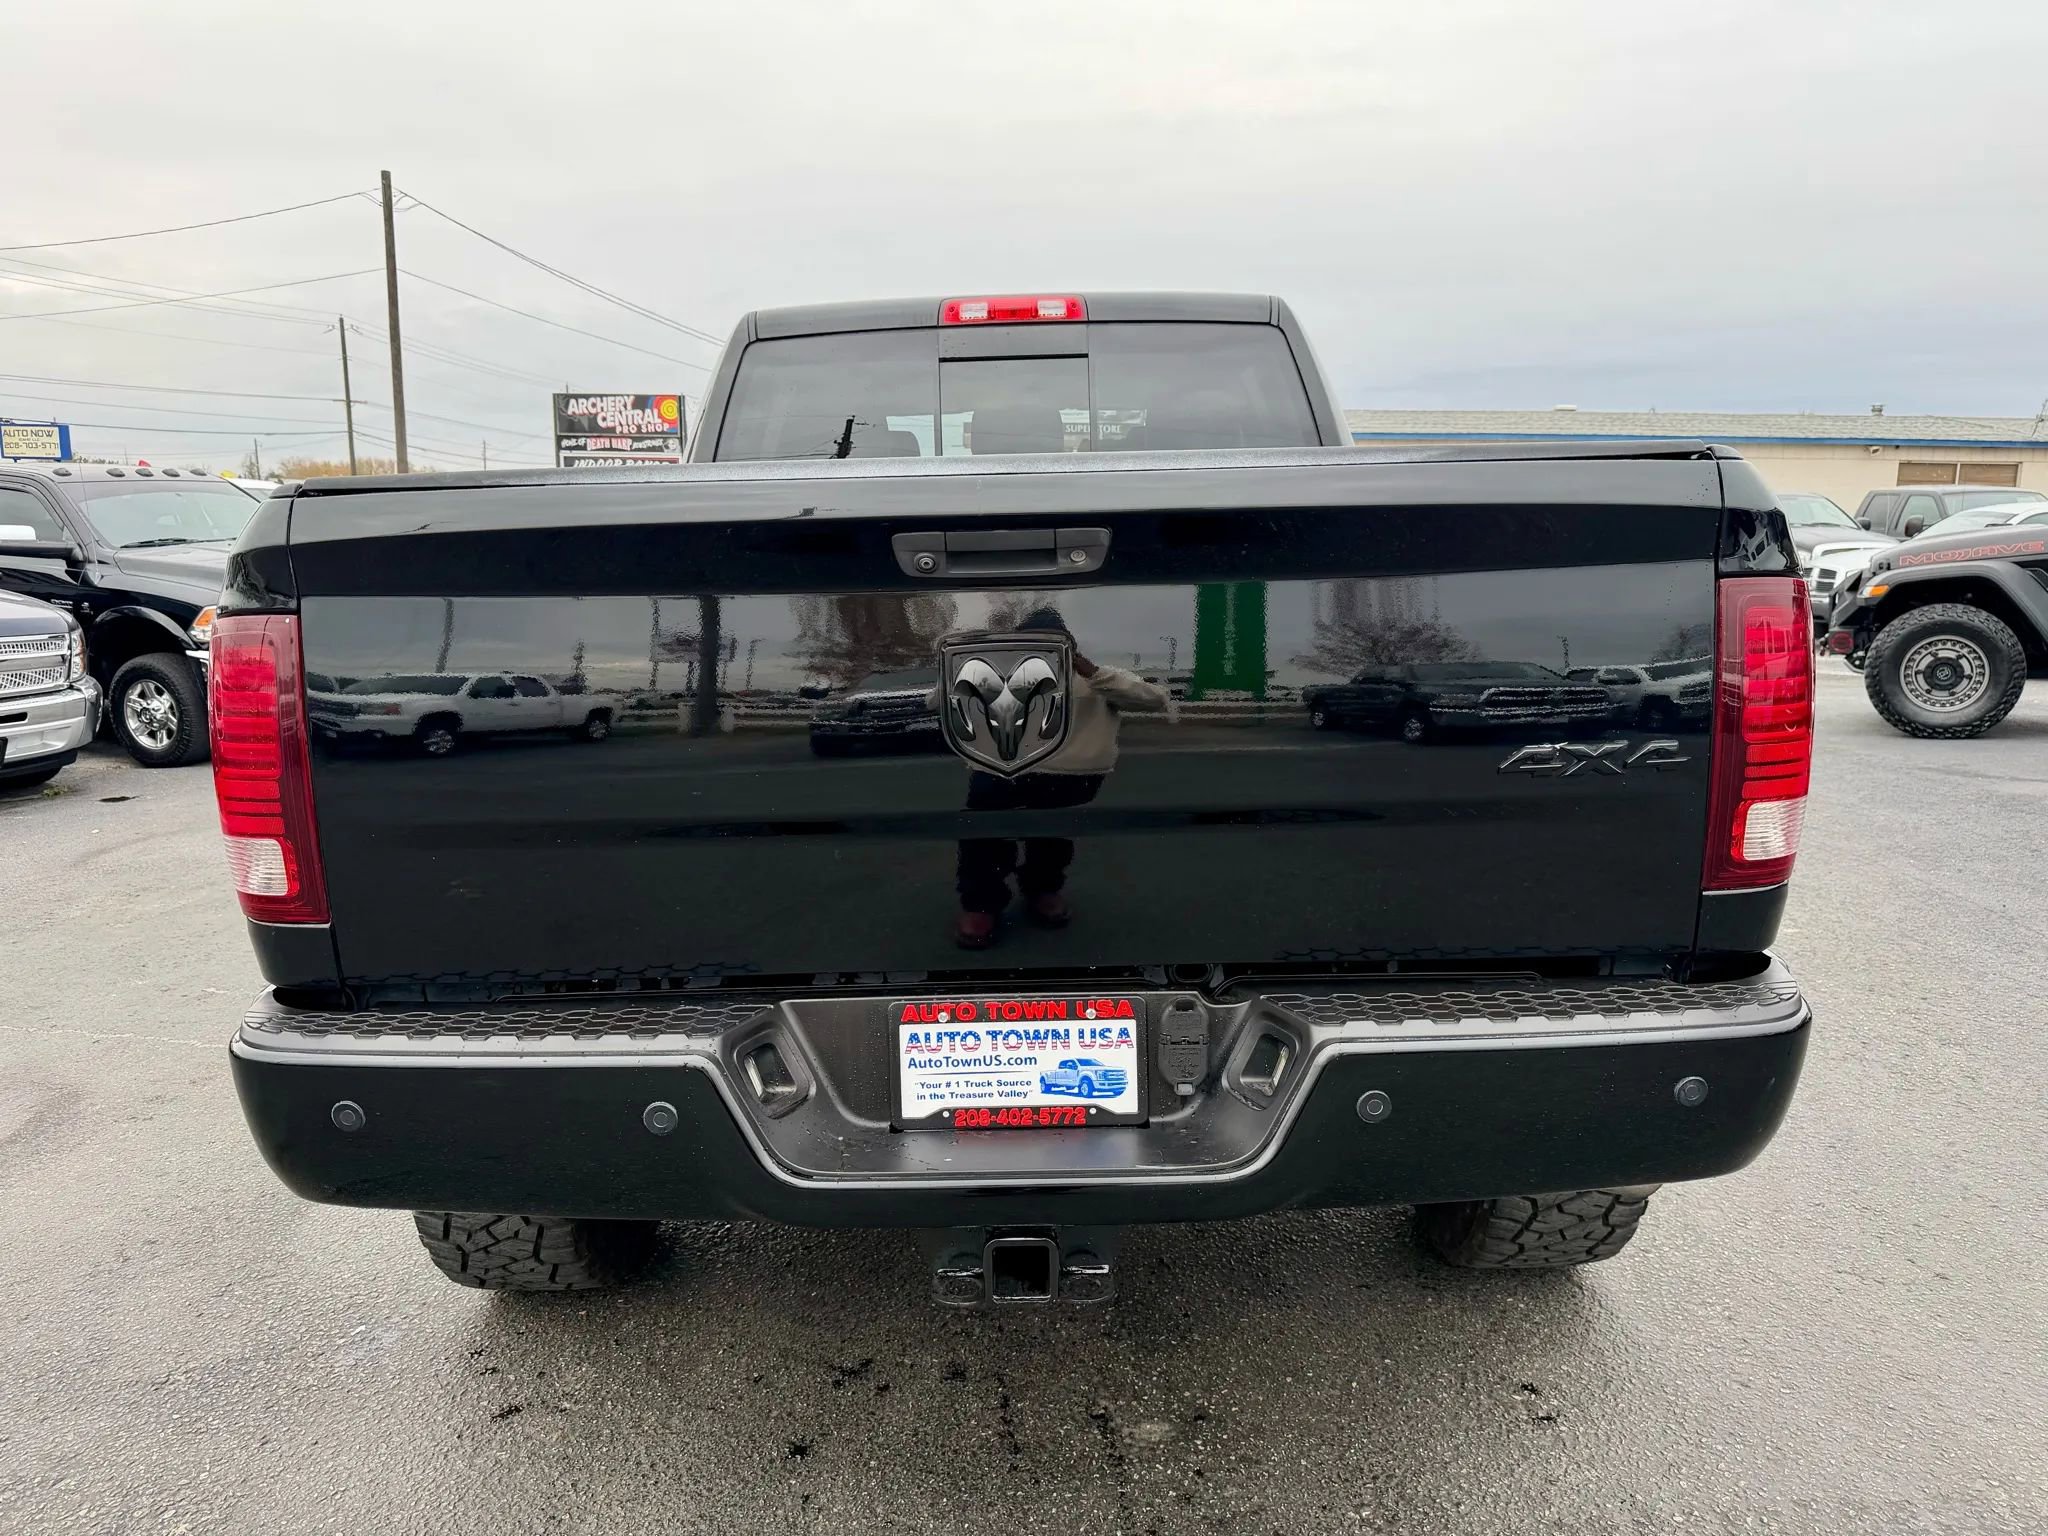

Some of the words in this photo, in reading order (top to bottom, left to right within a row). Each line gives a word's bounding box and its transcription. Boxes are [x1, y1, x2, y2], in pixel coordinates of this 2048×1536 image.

[567, 396, 635, 416] ARCHERY
[596, 408, 662, 429] CENTRAL
[616, 424, 637, 434] PRO
[641, 423, 669, 433] SHOP
[3, 429, 28, 438] AUTO
[30, 429, 54, 437] NOW
[1899, 540, 2045, 567] MOJAVE
[901, 1003, 977, 1022] AUTO
[984, 1000, 1067, 1020] TOWN
[1076, 999, 1134, 1019] USA
[905, 1030, 981, 1054] AUTO
[986, 1028, 1070, 1051] TOWN
[1077, 1027, 1134, 1050] USA
[907, 1055, 1037, 1069] AutoTownUS.com
[964, 1078, 993, 1088] Truck
[996, 1078, 1032, 1087] Source
[916, 1092, 926, 1101] in
[929, 1091, 946, 1100] the
[949, 1090, 994, 1099] Treasure
[954, 1106, 1087, 1127] 208-402-5772
